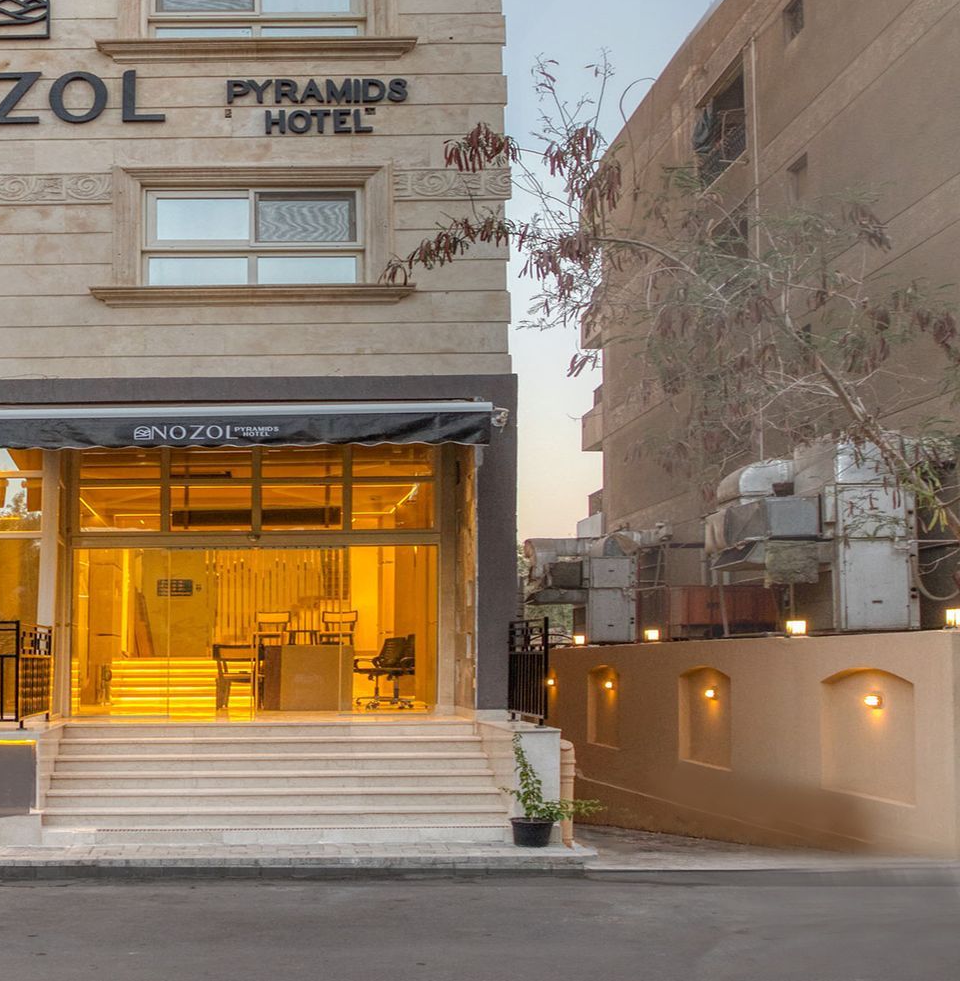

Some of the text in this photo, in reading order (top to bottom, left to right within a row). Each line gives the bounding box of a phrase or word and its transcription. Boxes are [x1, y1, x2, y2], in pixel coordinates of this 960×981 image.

[226, 78, 408, 105] PYRAMIDS
[265, 108, 374, 135] HOTEL
[151, 424, 238, 440] NOZOL
